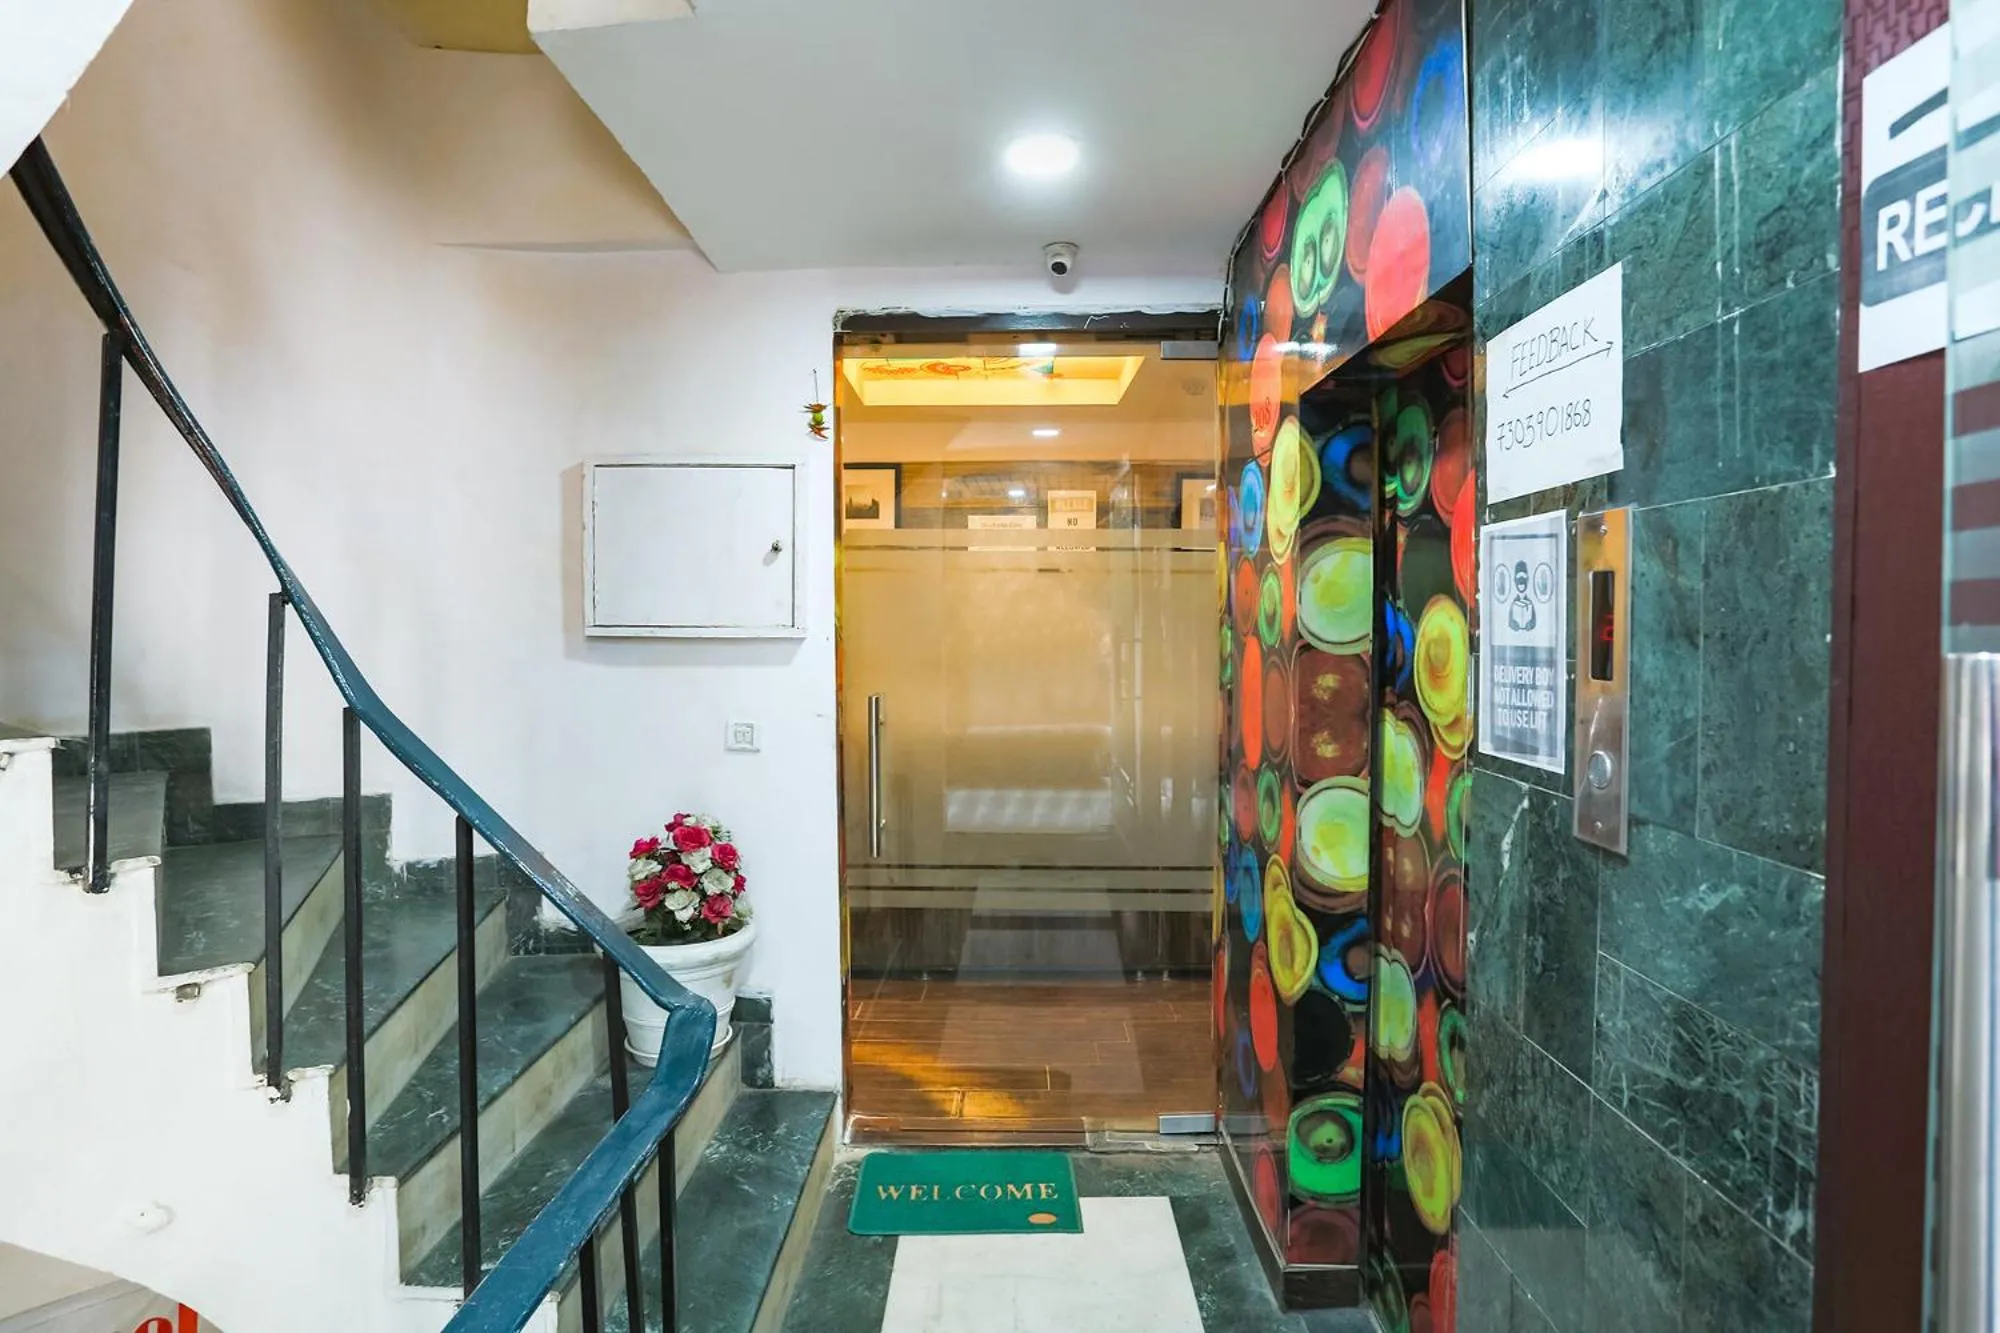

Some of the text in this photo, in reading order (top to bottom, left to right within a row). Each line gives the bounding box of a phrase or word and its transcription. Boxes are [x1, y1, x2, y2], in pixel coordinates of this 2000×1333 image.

[1510, 315, 1598, 380] FEEDBACK
[1497, 398, 1591, 451] 7305901868
[1494, 665, 1554, 686] DELIVERY BOY
[1493, 685, 1509, 705] NOT
[1510, 709, 1528, 728] USE
[877, 1183, 1058, 1201] WELCOME
